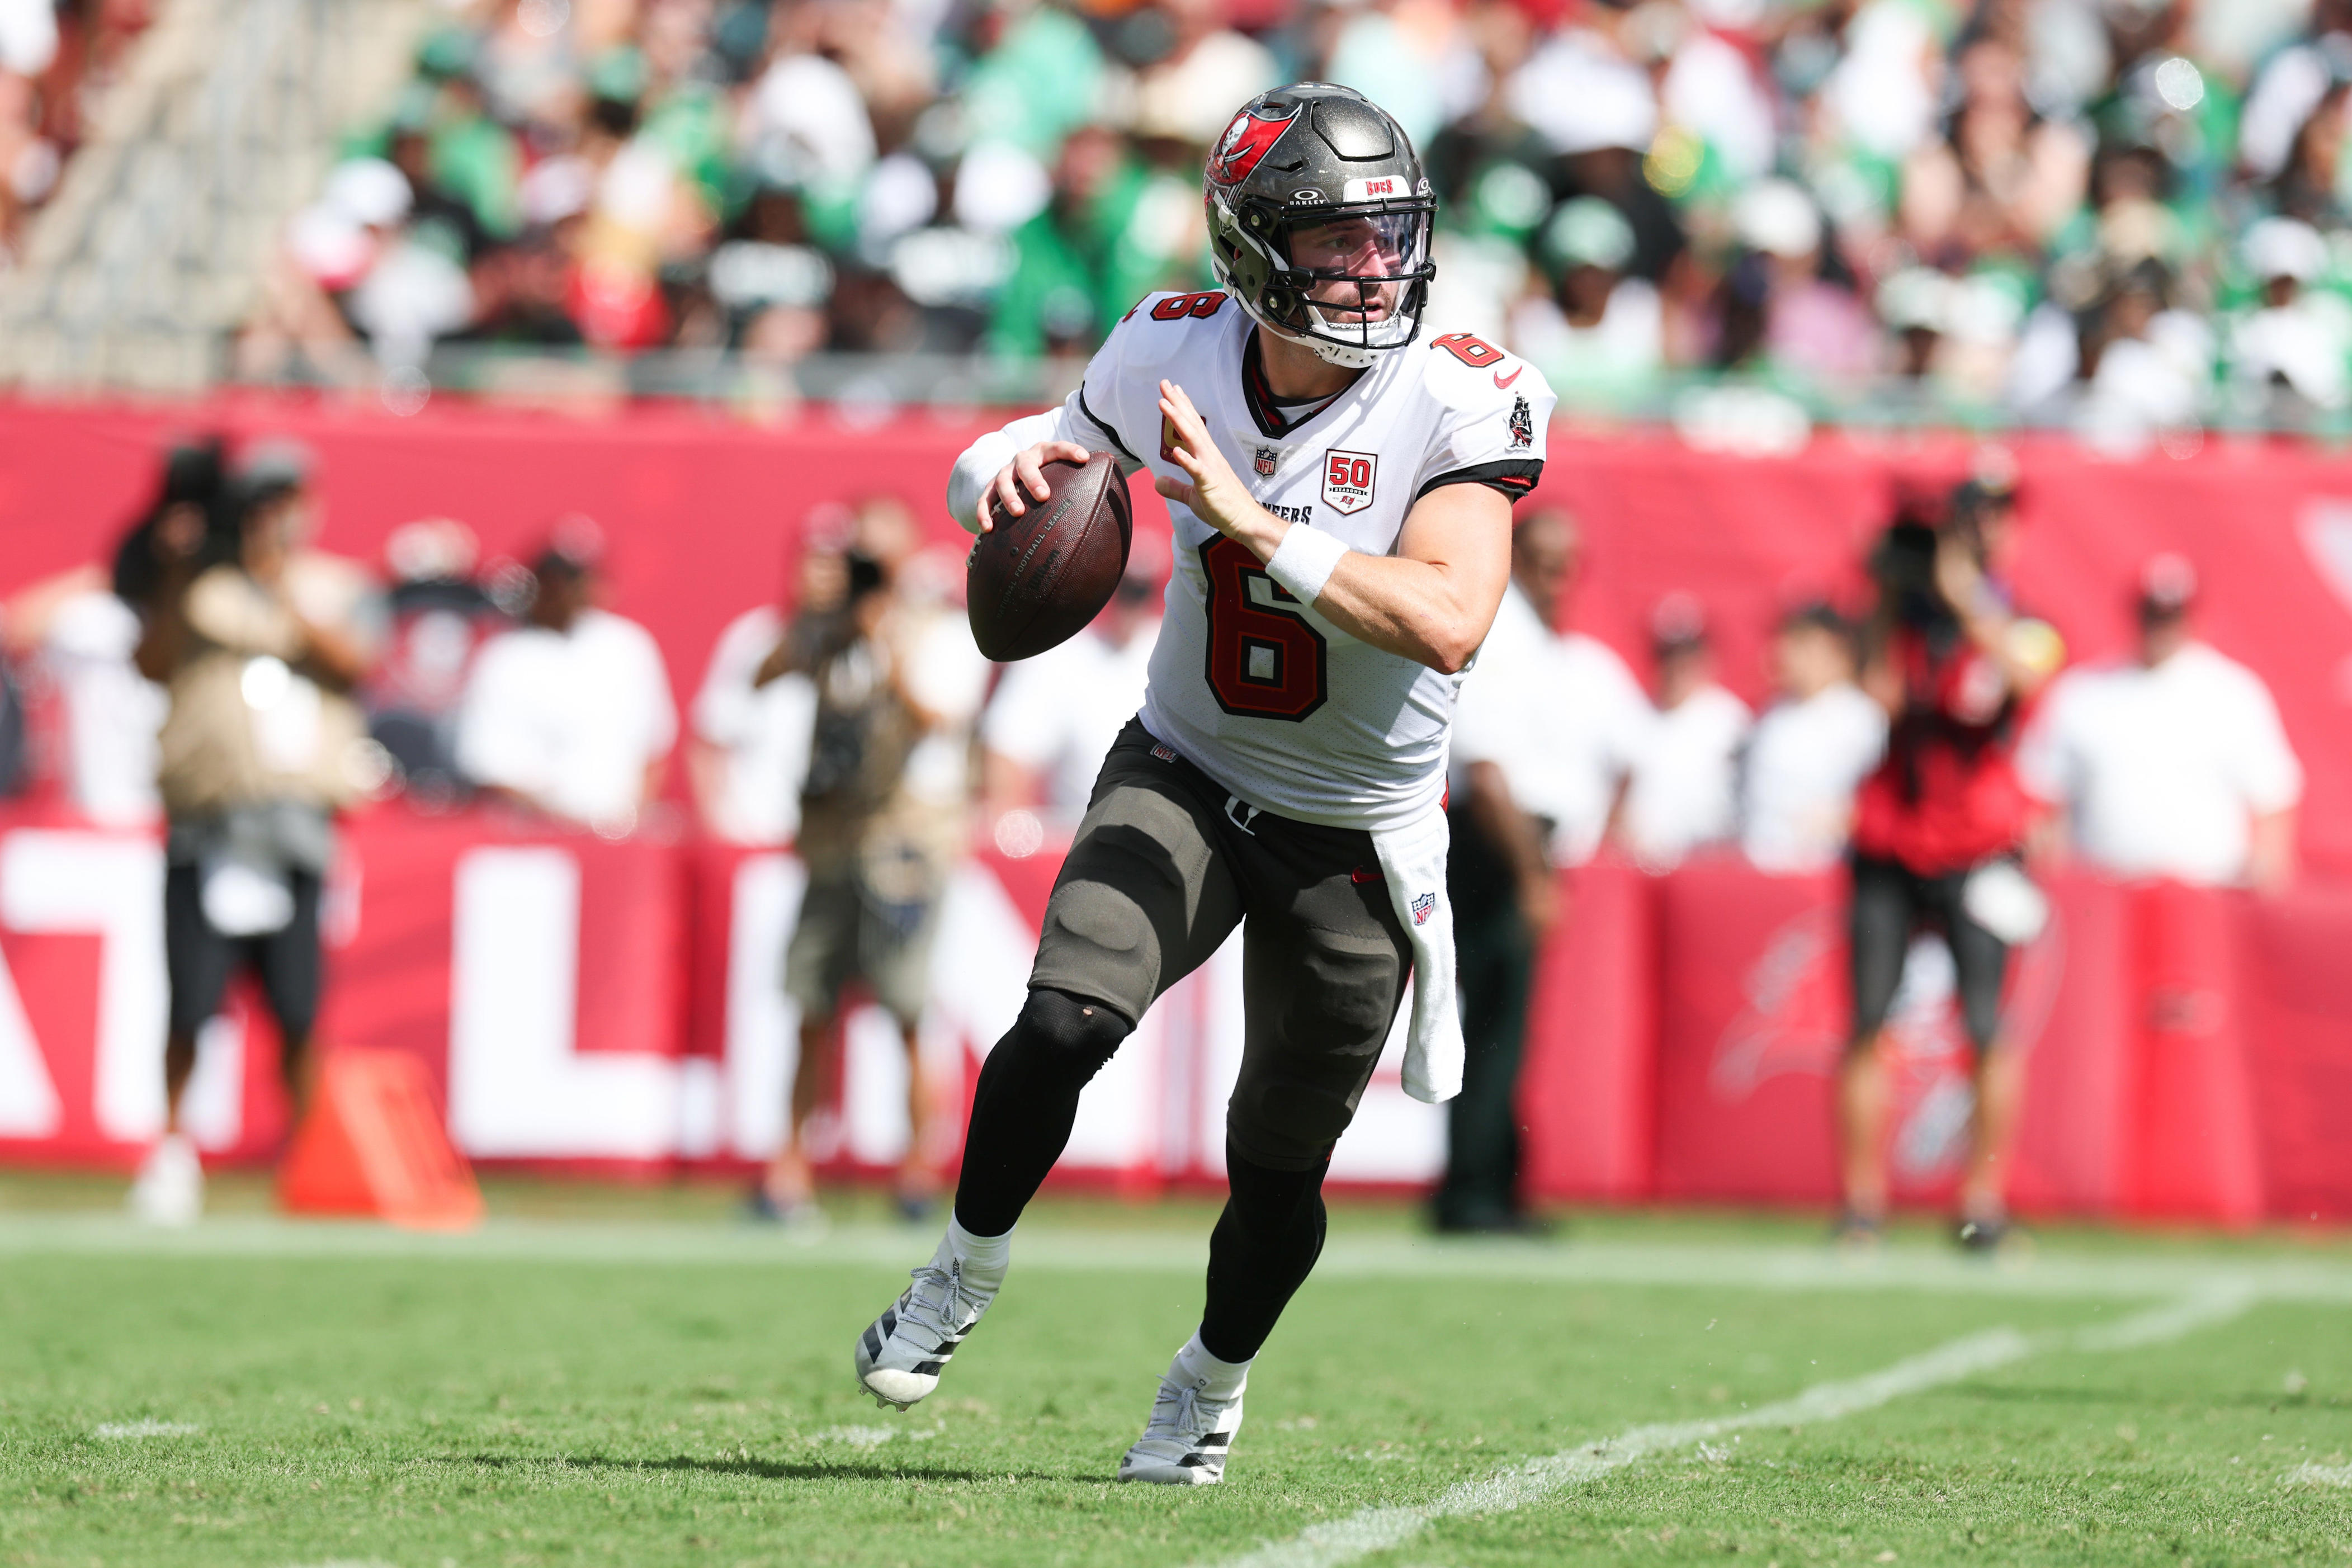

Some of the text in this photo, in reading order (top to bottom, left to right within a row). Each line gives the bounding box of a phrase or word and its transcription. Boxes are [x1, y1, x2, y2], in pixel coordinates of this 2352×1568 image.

[1366, 179, 1394, 196] BUCS
[1429, 333, 1505, 367] 6
[1257, 459, 1273, 474] NFL
[1329, 456, 1371, 488] 50
[996, 581, 1017, 619] NATIONAL
[1014, 533, 1046, 578] FOOTBALL
[1044, 498, 1073, 531] LEAGUE
[1198, 531, 1328, 723] 6
[1154, 747, 1173, 759] NFL
